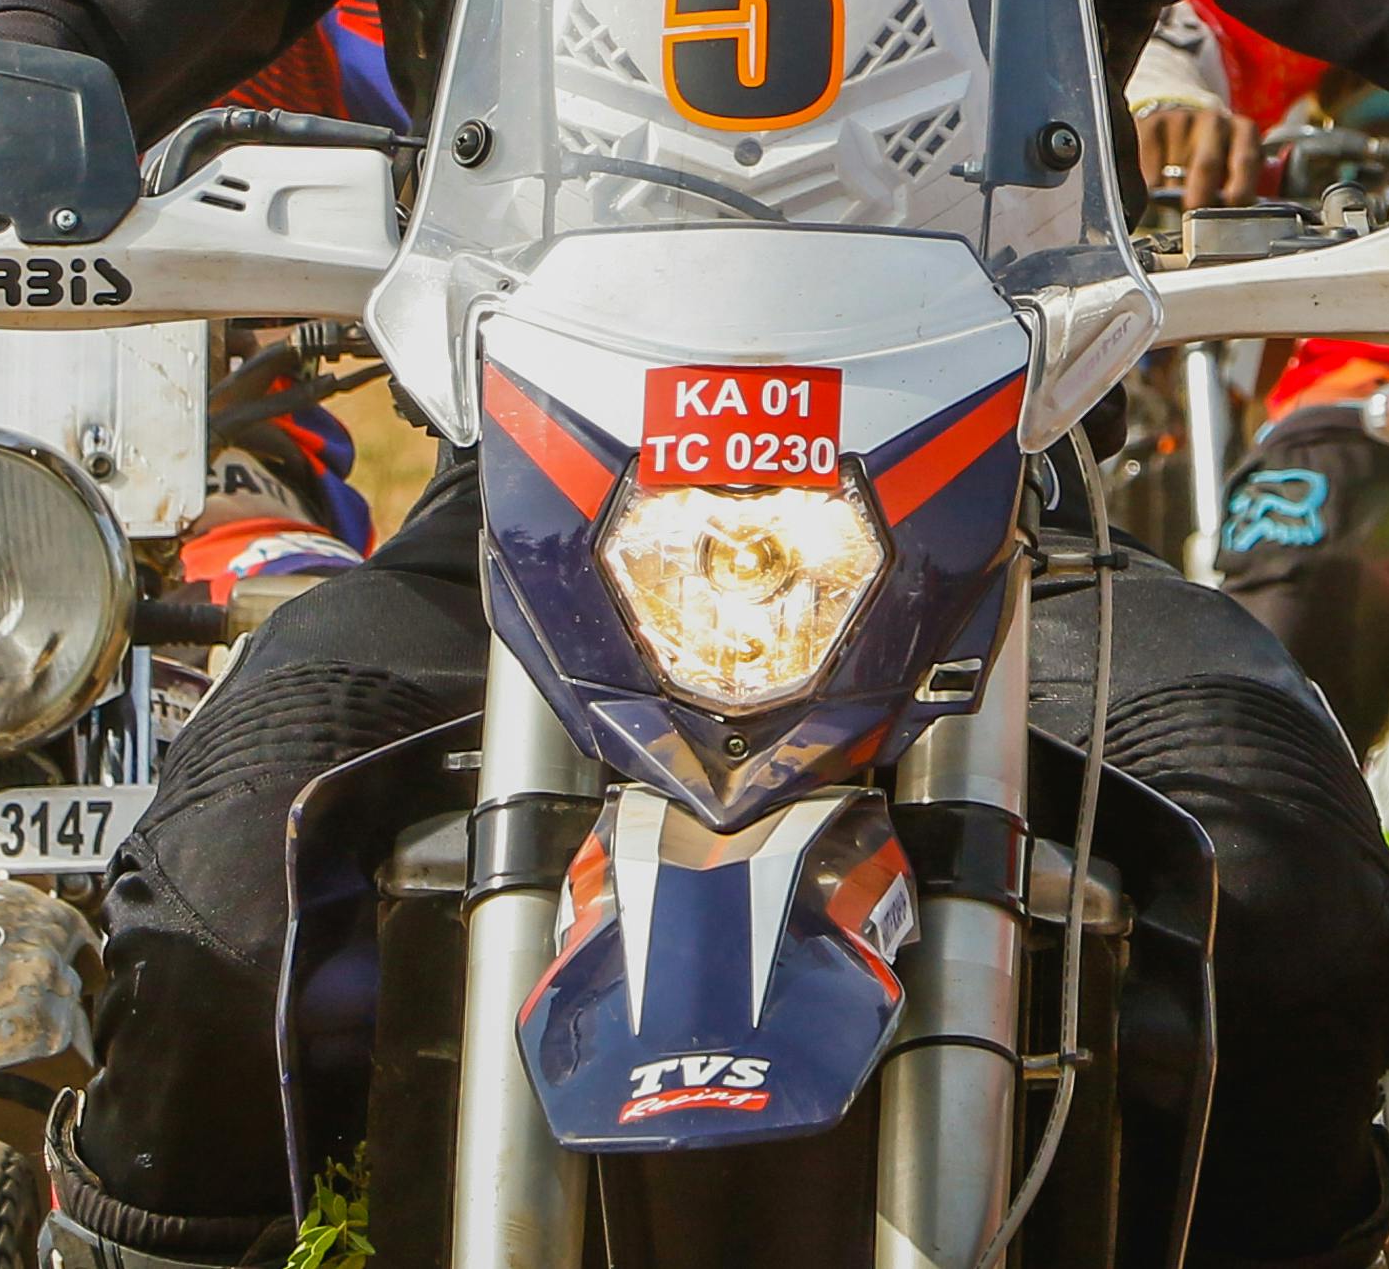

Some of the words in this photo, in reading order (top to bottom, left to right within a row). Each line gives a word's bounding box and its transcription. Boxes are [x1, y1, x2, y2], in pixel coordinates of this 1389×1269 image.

[674, 380, 747, 417] KA
[761, 379, 811, 418] 01
[646, 435, 709, 473] TC
[725, 433, 836, 475] 0230
[0, 800, 113, 857] 3147
[629, 1055, 771, 1099] TVS
